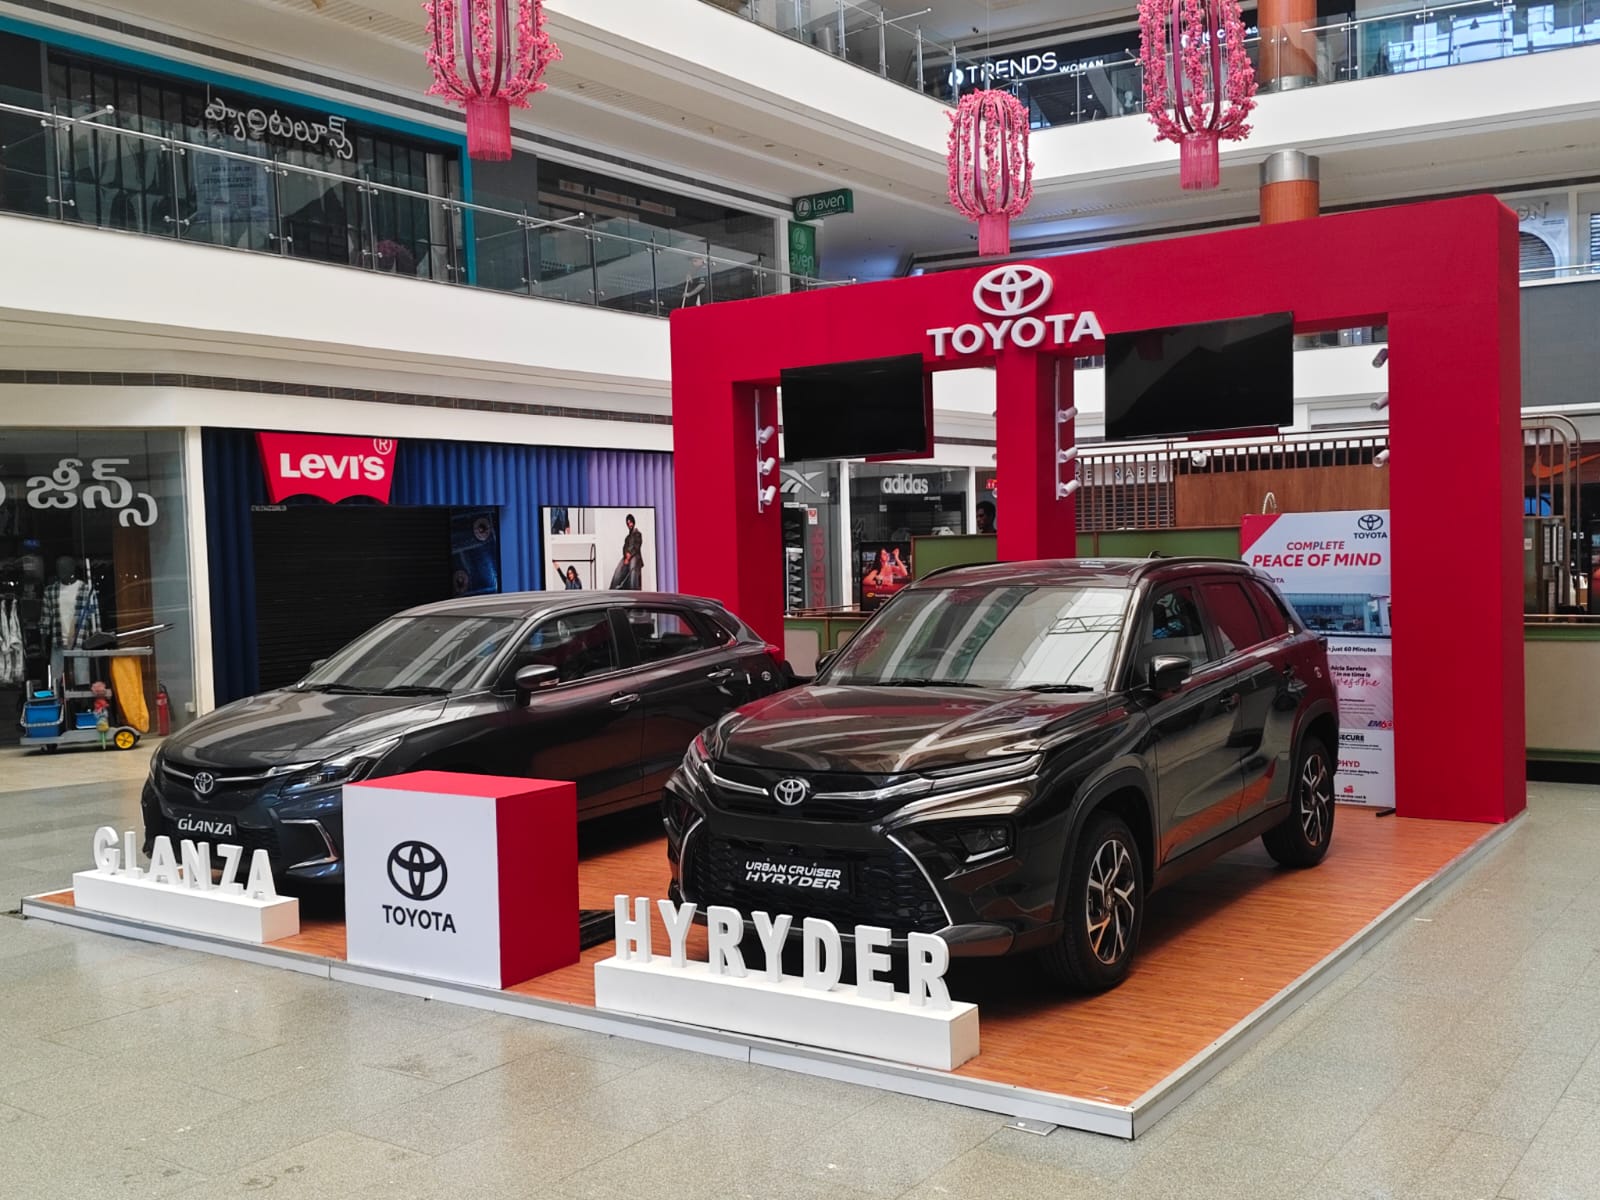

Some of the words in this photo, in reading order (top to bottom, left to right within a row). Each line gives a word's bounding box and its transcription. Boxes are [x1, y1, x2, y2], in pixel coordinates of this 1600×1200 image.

[966, 52, 1057, 84] TRENDS
[1059, 60, 1104, 73] WOMAN
[812, 195, 845, 211] laven
[926, 311, 1106, 357] TOYOTA
[26, 458, 158, 527] జీన్స్
[882, 473, 929, 494] adidas
[1353, 531, 1388, 540] TOYOTA
[1286, 541, 1345, 551] COMPLETE
[1252, 554, 1304, 568] PEACE
[1307, 554, 1330, 567] OF
[1333, 553, 1382, 567] MIND
[1331, 645, 1343, 653] just
[177, 818, 233, 836] GLANZA
[93, 826, 277, 902] GLANZA
[745, 861, 787, 873] URBAN
[788, 865, 842, 879] CRUISER
[745, 871, 841, 890] HYRYDER
[382, 904, 457, 934] TOYOTA
[614, 894, 952, 1011] HYRYDER
